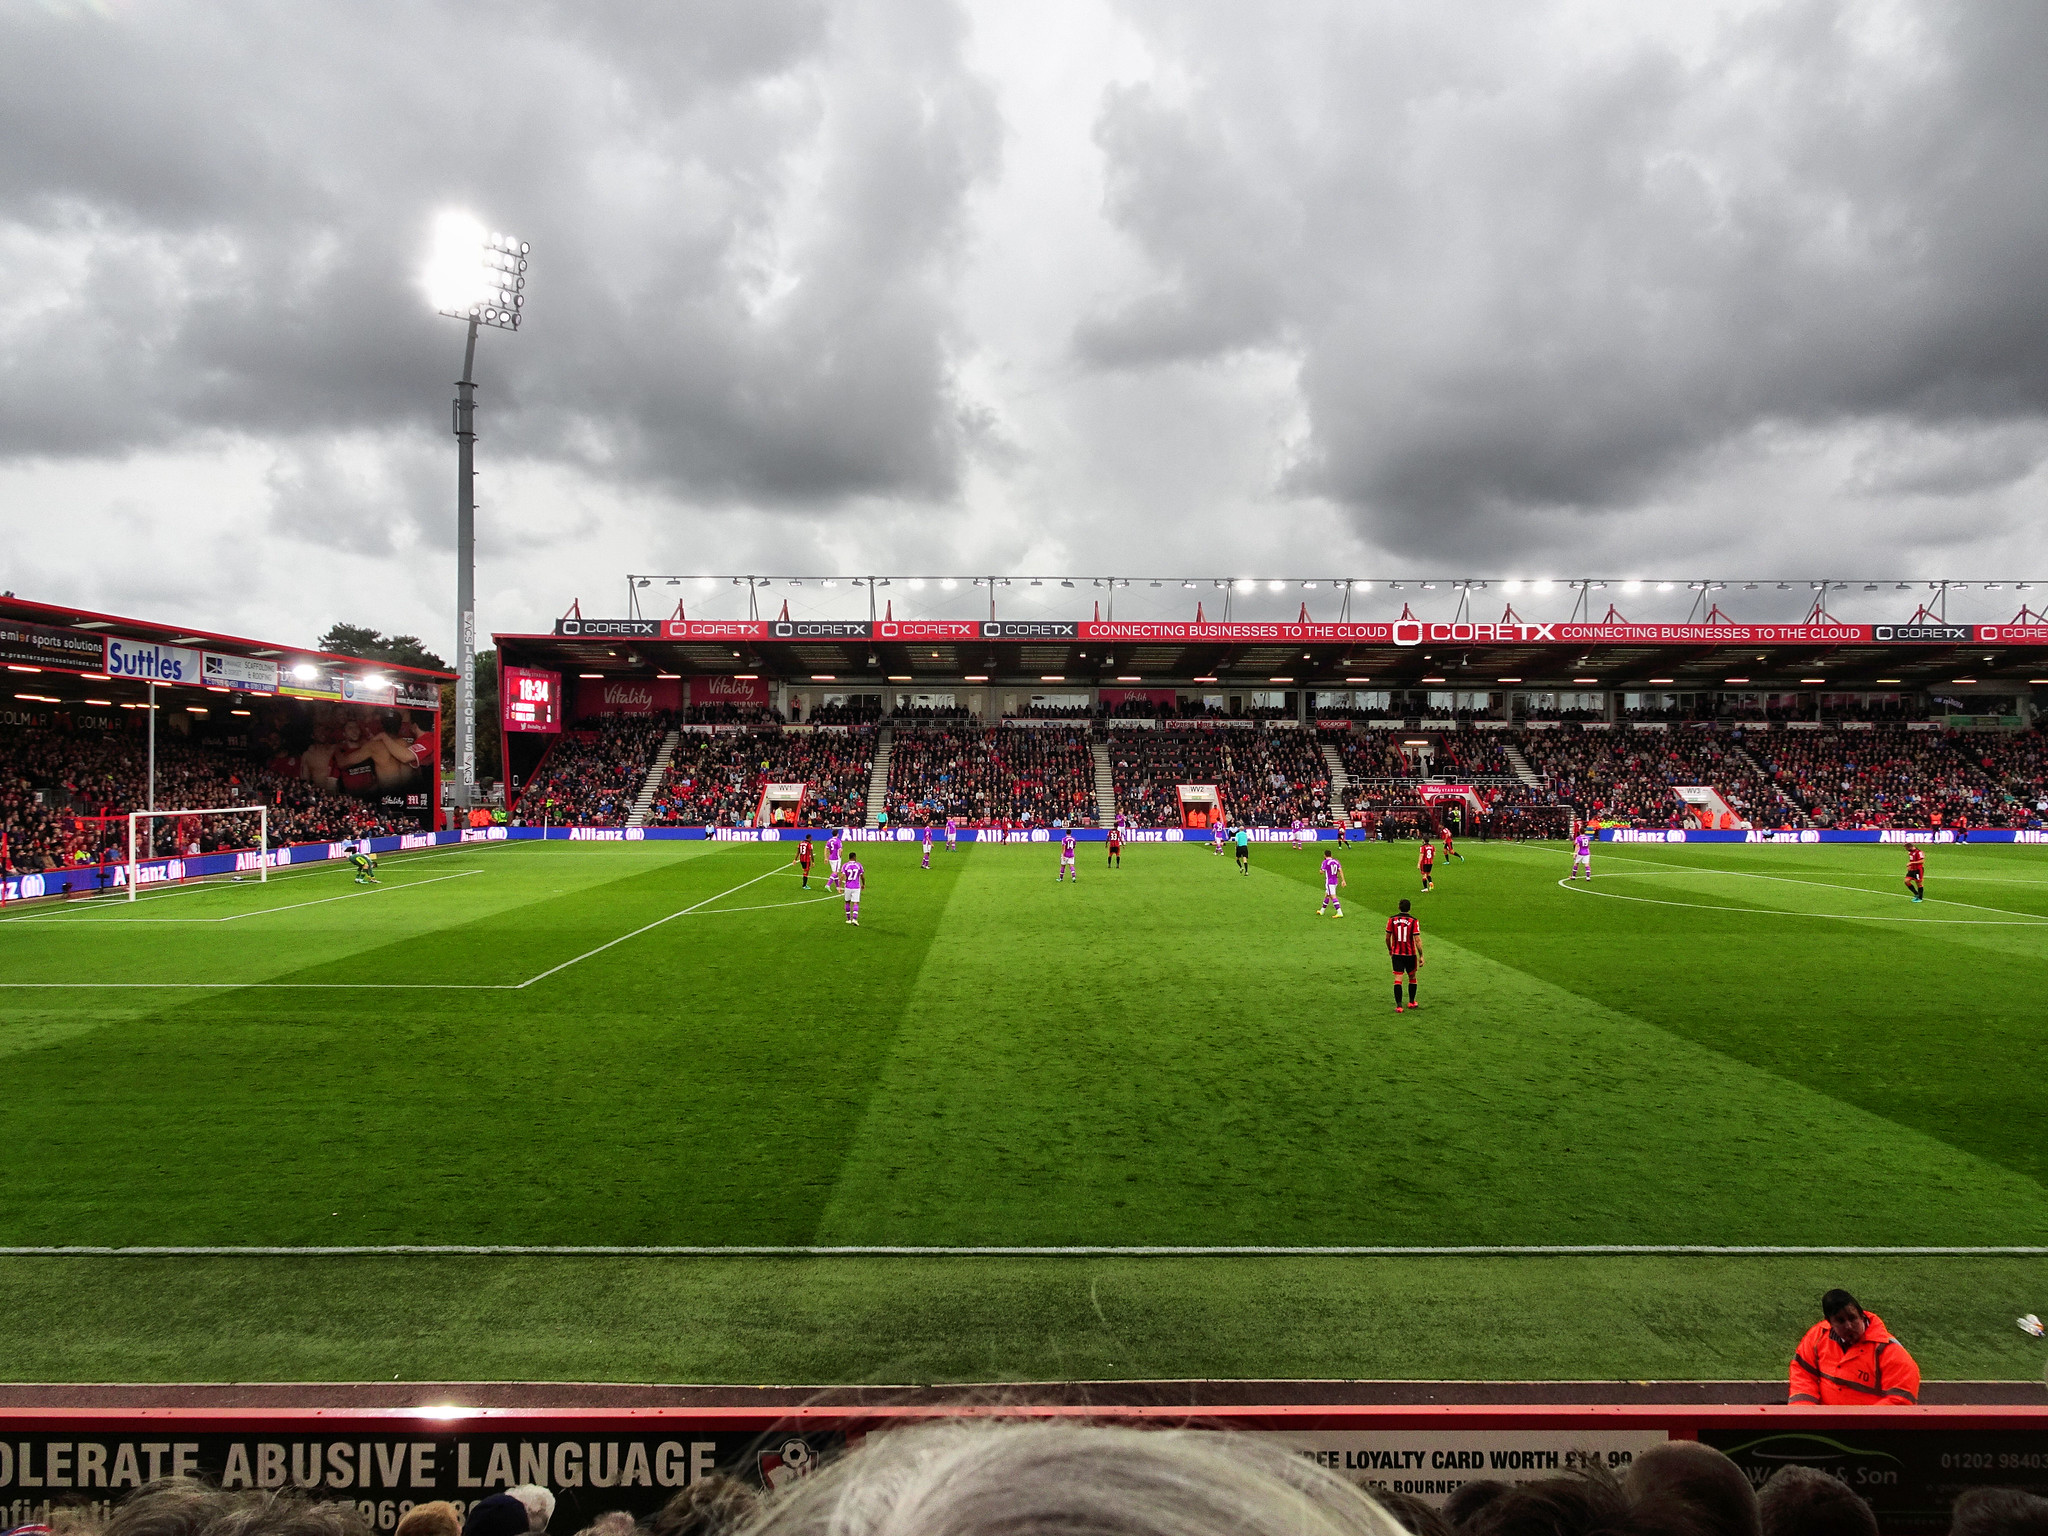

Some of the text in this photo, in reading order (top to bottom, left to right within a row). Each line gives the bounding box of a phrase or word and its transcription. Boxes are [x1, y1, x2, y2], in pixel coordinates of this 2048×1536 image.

[585, 623, 654, 634] CORETX
[691, 624, 760, 635] CORETX
[797, 624, 866, 635] CORETX
[902, 624, 971, 635] CORETX
[1005, 624, 1074, 635] CORETX
[1089, 624, 1387, 638] CONNECTING BUSINESSES TO THE CLOUD
[1430, 623, 1556, 641] CORETX
[1561, 627, 1860, 639] CONNECTING BUSINESSES TO THE CLOUD
[1897, 628, 1965, 639] CORETX
[32, 635, 62, 649] sports
[63, 638, 103, 653] solutions
[109, 642, 183, 680] Suttles
[519, 678, 549, 702] 18:34
[708, 675, 755, 700] Vitality
[463, 646, 474, 752] LABORATORIES
[603, 683, 653, 711] Vitality
[569, 827, 623, 841] Allianz
[841, 828, 894, 841] Allianz
[1109, 832, 1118, 841] 33
[1612, 830, 1666, 843] Allianz
[1879, 830, 1933, 843] Allianz
[401, 834, 427, 850] Allianz
[1067, 840, 1075, 850] 14
[1426, 849, 1432, 859] 8
[847, 868, 859, 881] 27
[1330, 863, 1338, 876] 10
[1397, 925, 1408, 943] 11
[1857, 1369, 1870, 1382] 70
[222, 1442, 437, 1489] ABUSIVE
[457, 1441, 716, 1488] LANGUAGE
[1346, 1450, 1426, 1470] LOYALTY
[1431, 1450, 1484, 1470] CARD
[1490, 1450, 1558, 1470] WORTH
[1941, 1453, 1993, 1469] 01202
[1856, 1466, 1898, 1485] Son
